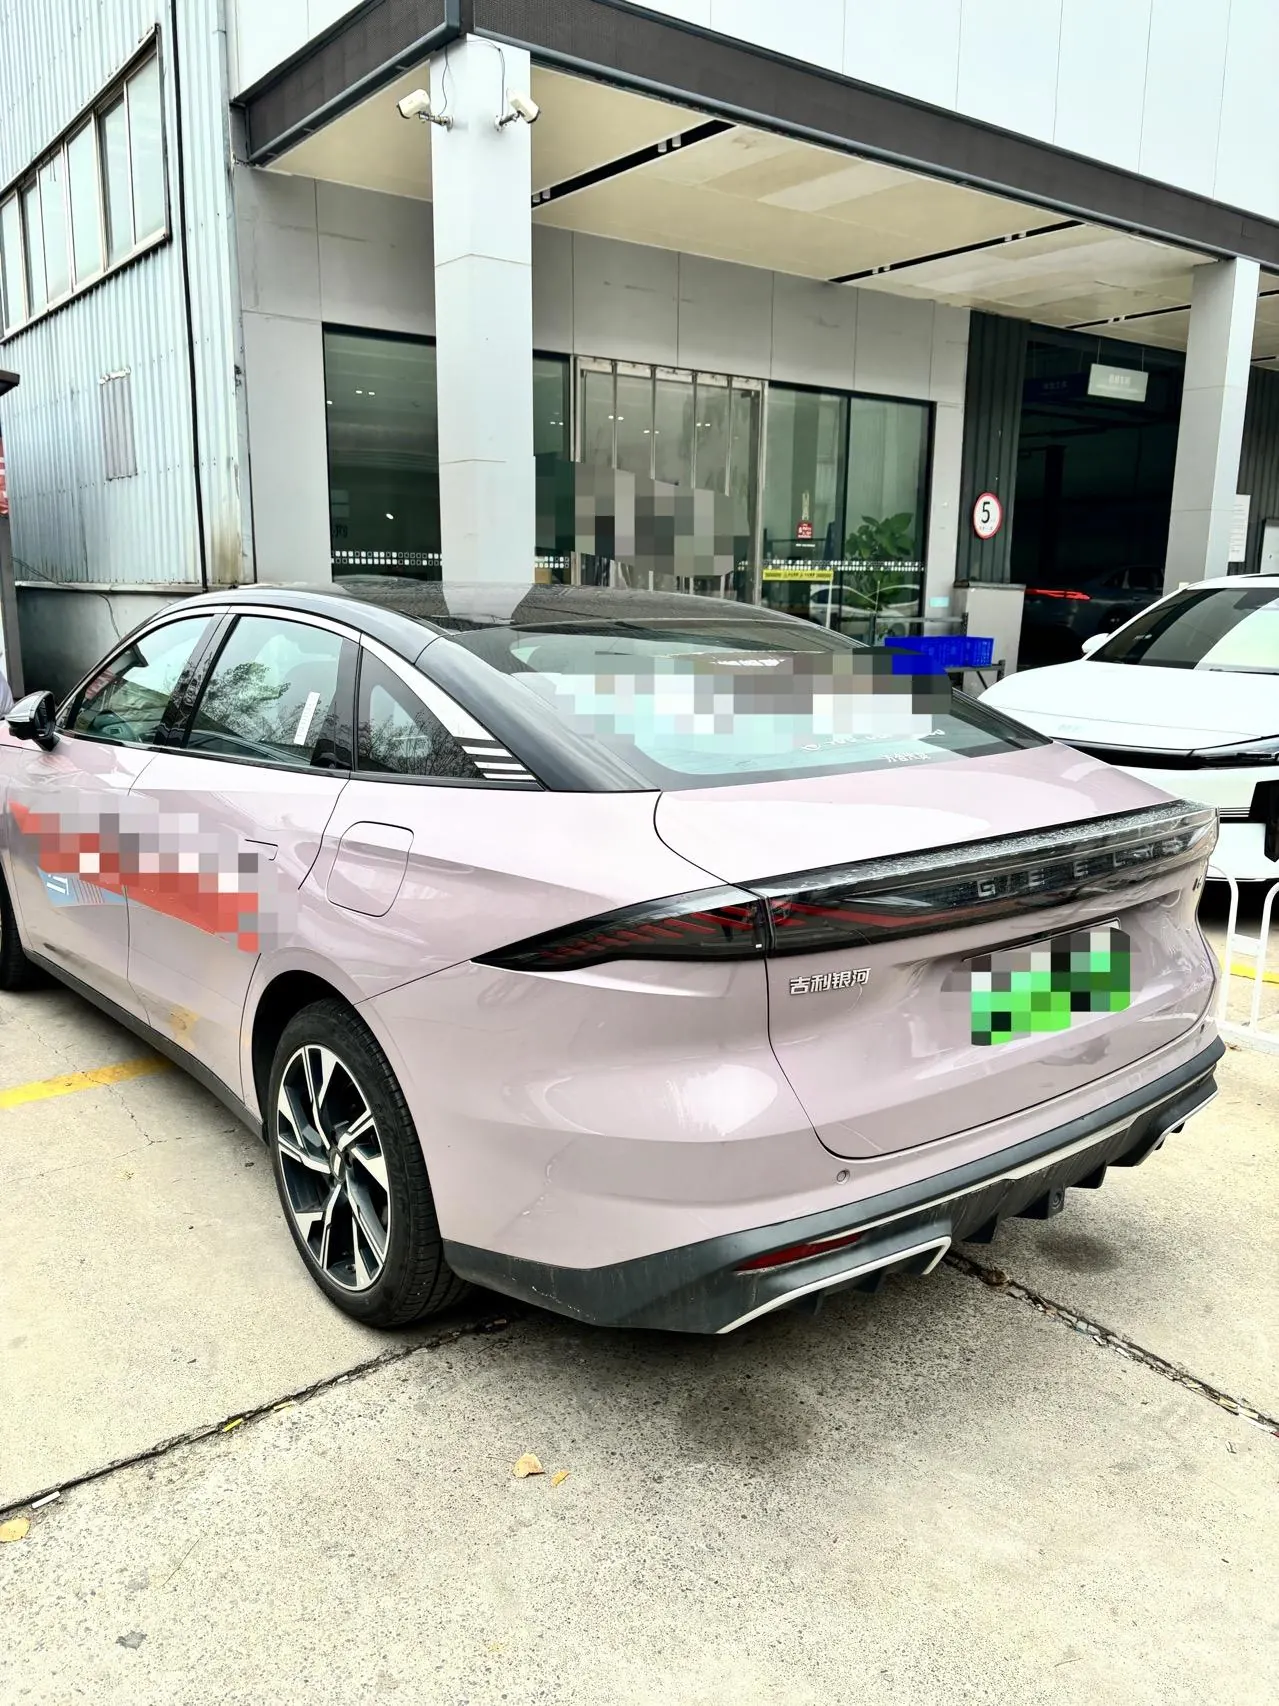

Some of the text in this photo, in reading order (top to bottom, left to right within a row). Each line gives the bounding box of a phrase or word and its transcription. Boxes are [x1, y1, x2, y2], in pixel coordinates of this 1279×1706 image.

[981, 501, 991, 524] 5
[790, 967, 871, 995] 吉利银河
